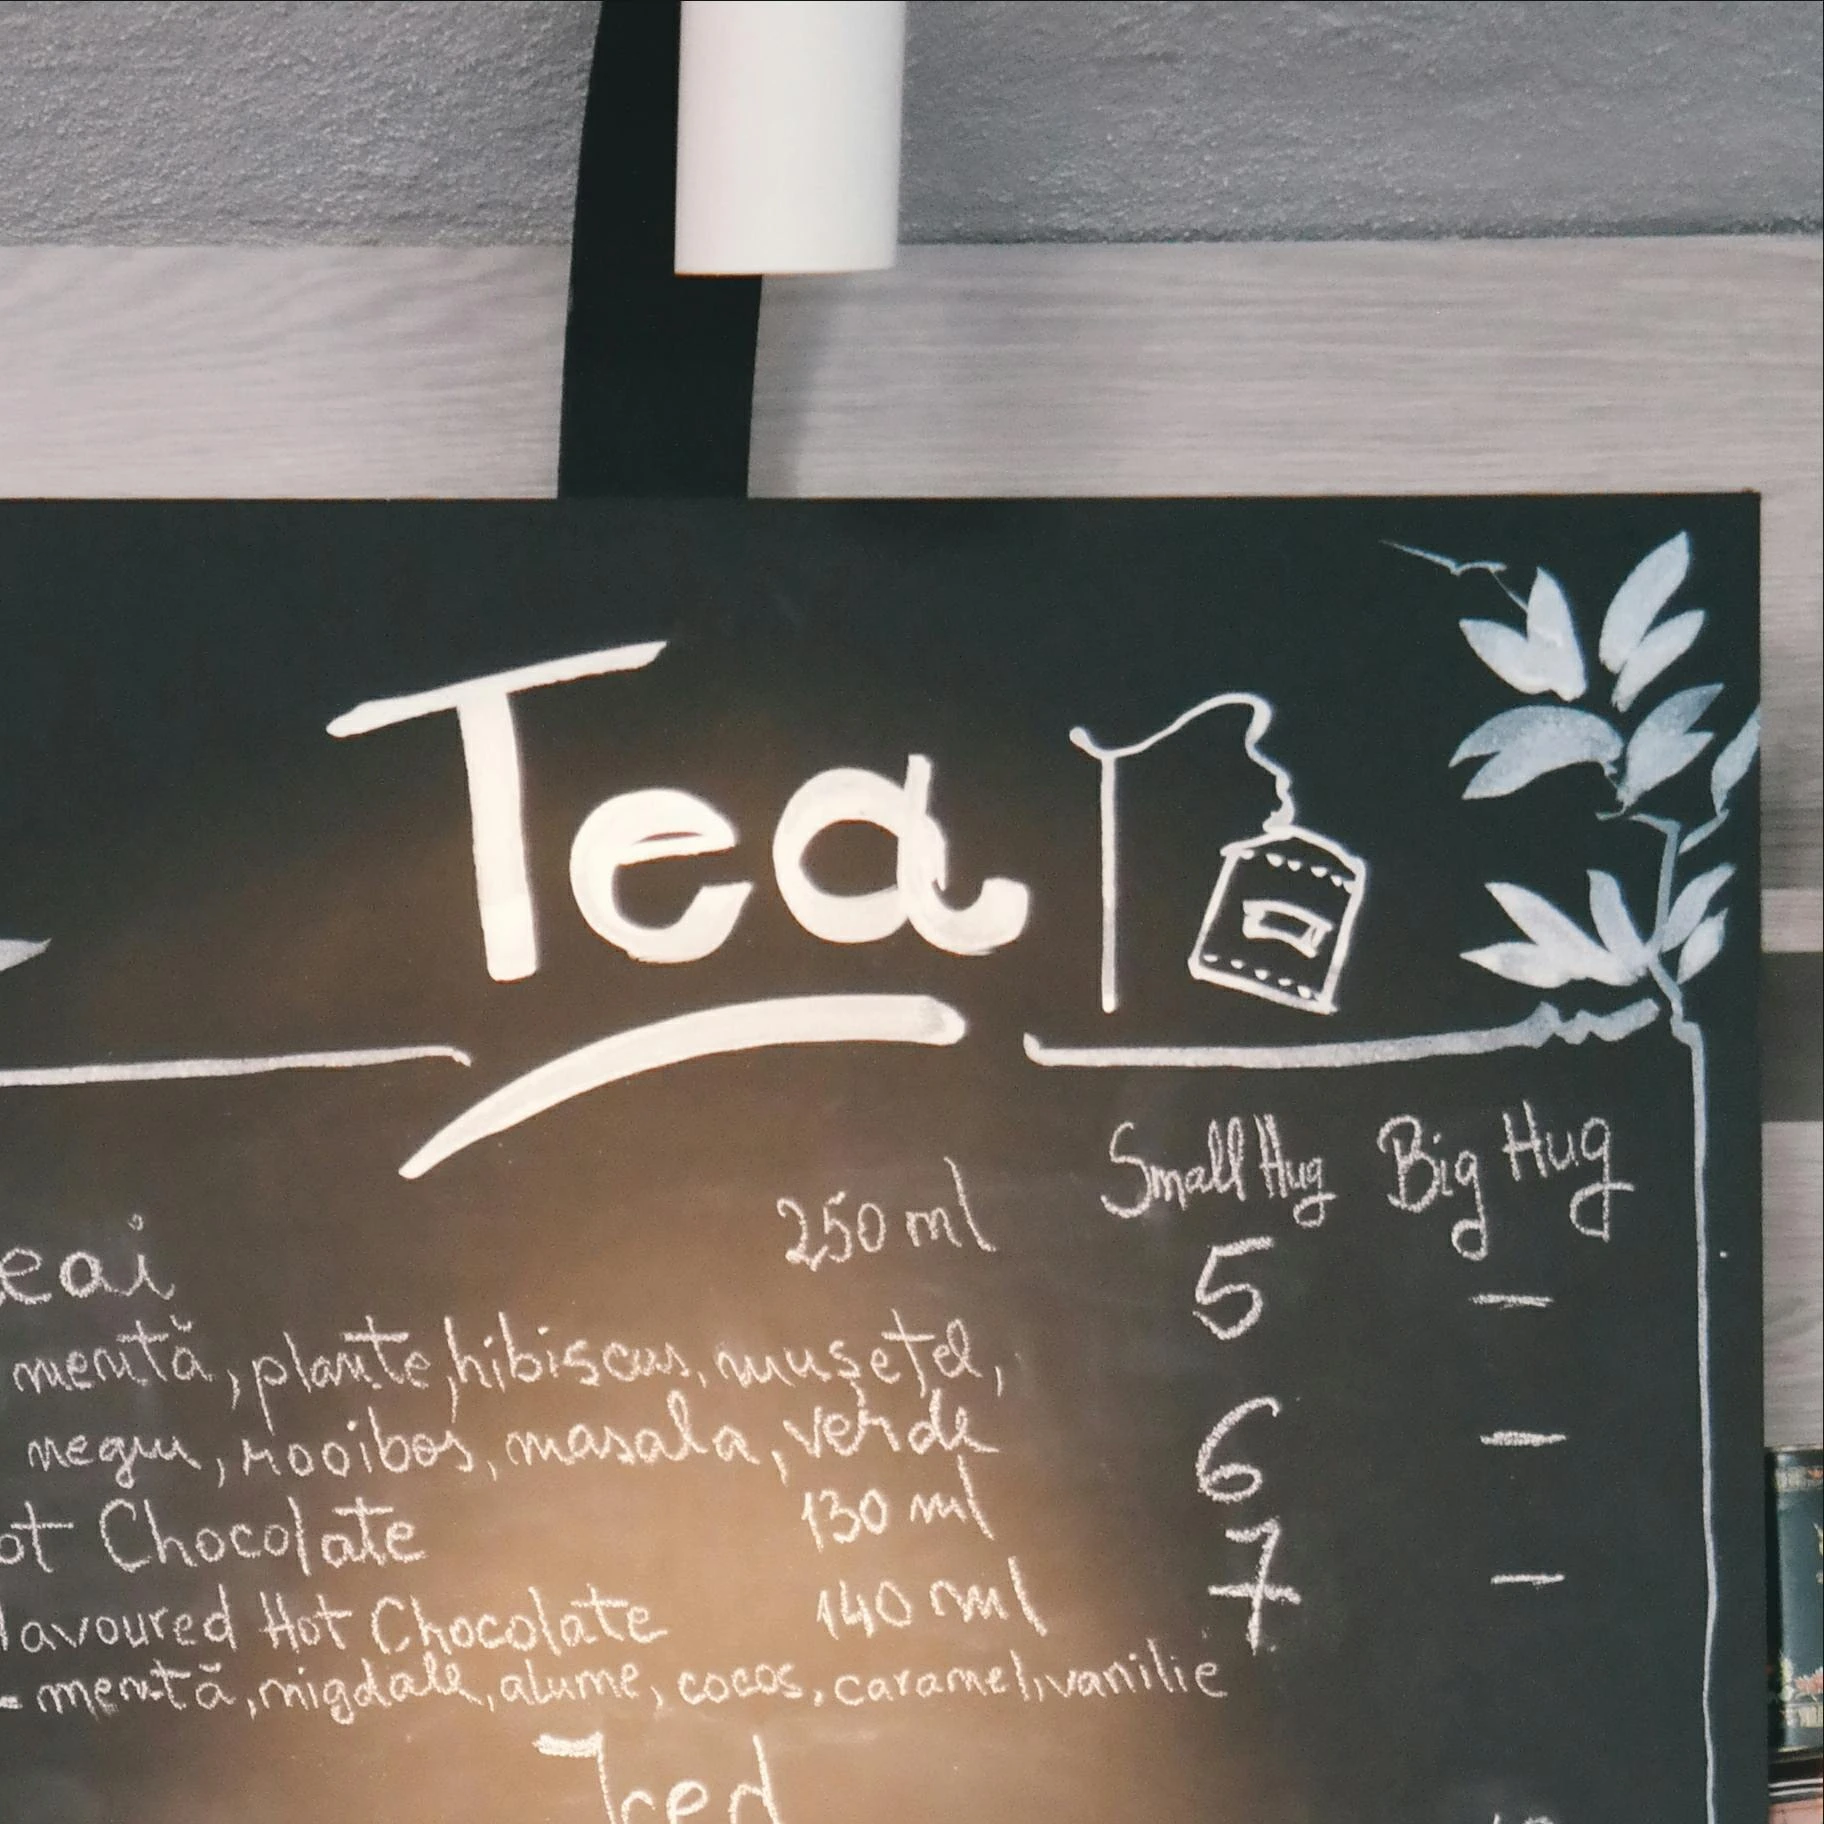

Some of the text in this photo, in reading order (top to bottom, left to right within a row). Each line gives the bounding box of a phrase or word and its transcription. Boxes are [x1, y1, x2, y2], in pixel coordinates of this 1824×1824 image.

[326, 640, 1030, 982] Tea
[1101, 1112, 1336, 1228] Small Hug
[1376, 1101, 1635, 1260] Big Hug
[776, 1191, 886, 1272] 250
[906, 1156, 996, 1252] ml
[1192, 1236, 1275, 1341] 5
[98, 1494, 428, 1576] Chocolate
[801, 1488, 889, 1553] 130
[909, 1455, 997, 1541] ml
[1194, 1395, 1282, 1505] 6
[783, 1388, 1000, 1460] verde
[258, 1591, 354, 1656] Hot
[373, 1583, 672, 1658] Chocolate
[816, 1579, 912, 1641] 140
[929, 1556, 1048, 1638] ml
[1207, 1515, 1302, 1656] 7
[1046, 1637, 1229, 1701] vanilie
